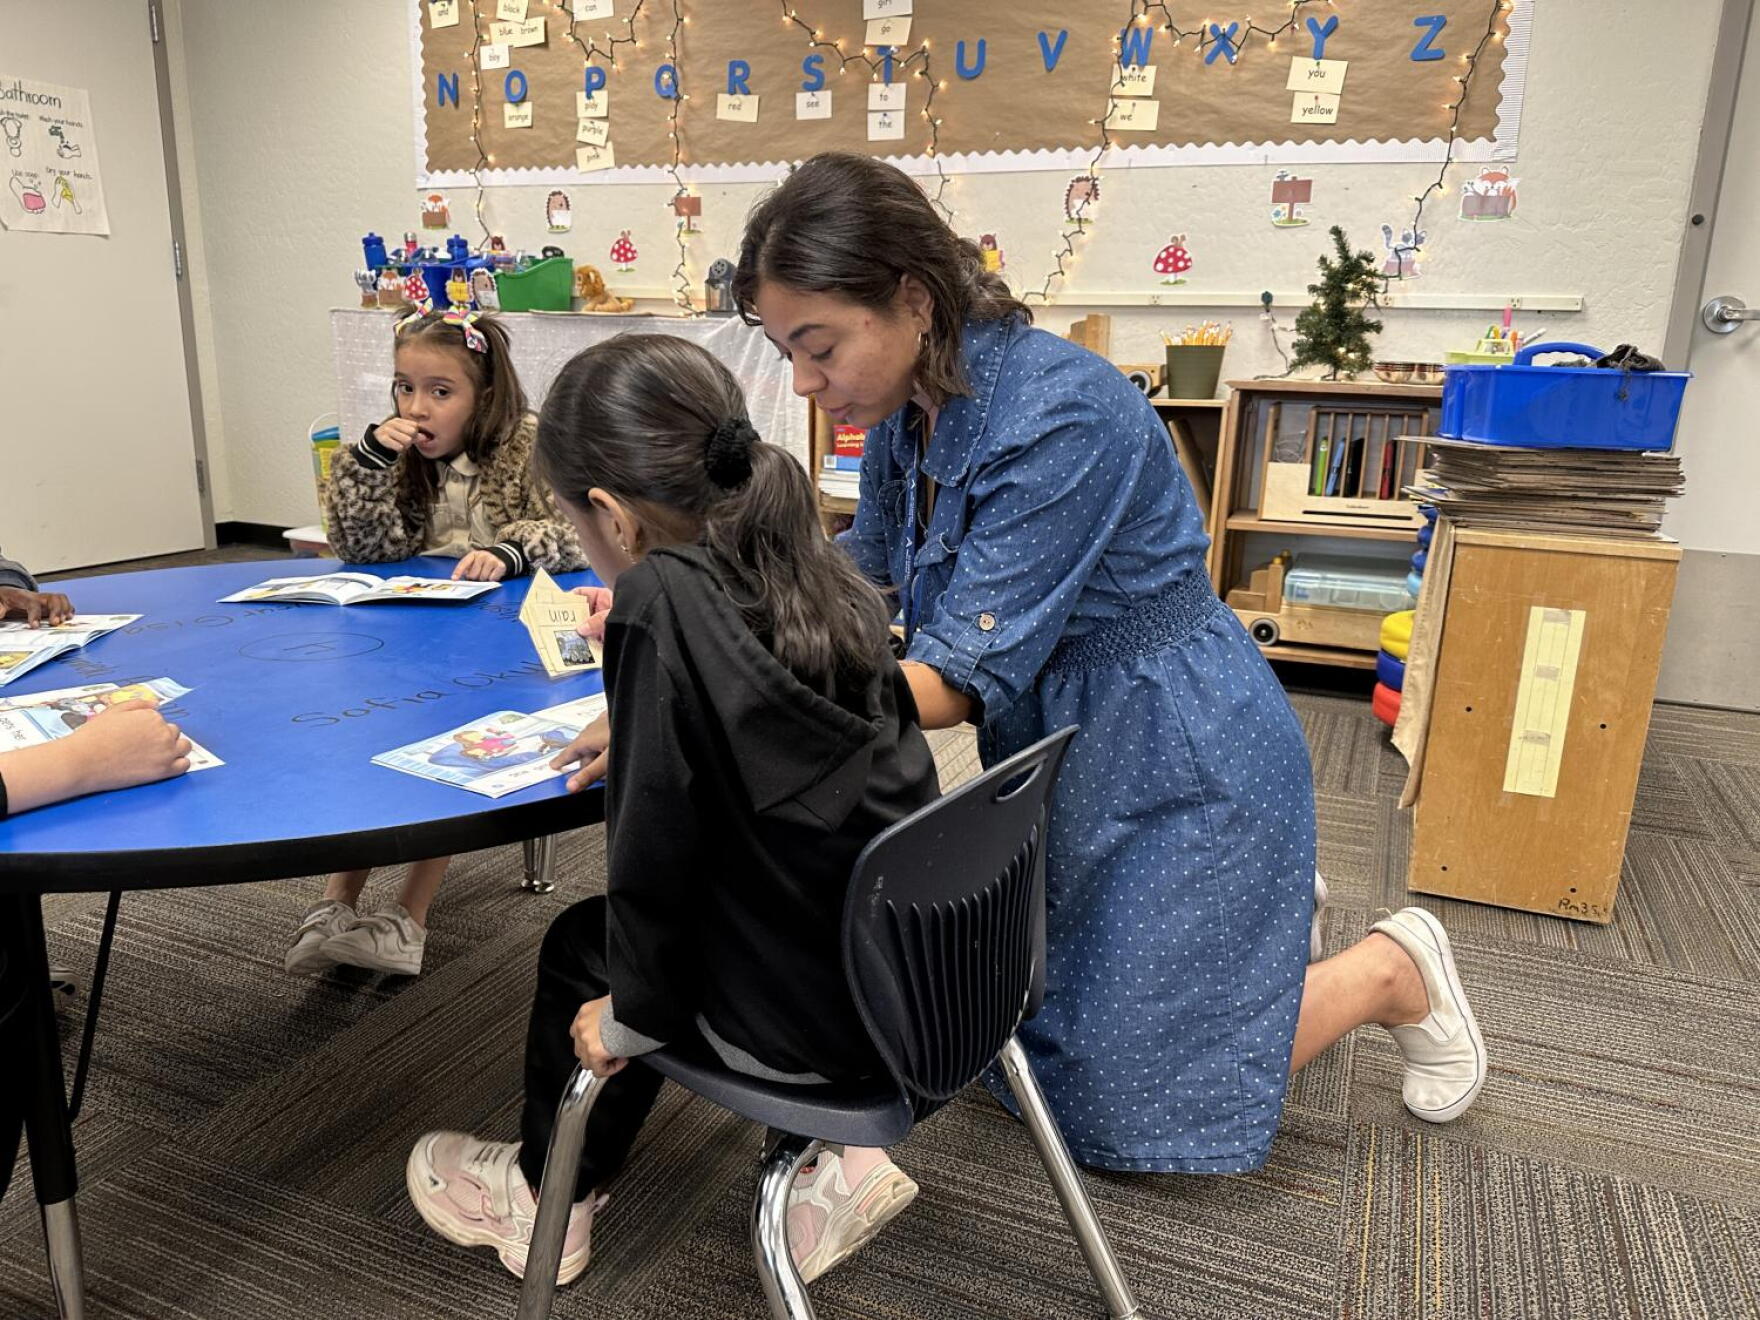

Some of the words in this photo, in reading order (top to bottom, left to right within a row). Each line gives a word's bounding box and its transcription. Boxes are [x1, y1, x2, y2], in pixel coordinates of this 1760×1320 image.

[881, 26, 891, 35] go
[437, 72, 459, 106] N
[504, 70, 527, 103] O
[585, 66, 606, 99] P
[655, 64, 679, 98] Q
[727, 60, 750, 95] R
[803, 55, 825, 92] S
[877, 46, 899, 87] T
[956, 39, 986, 80] U
[1038, 30, 1068, 72] V
[1120, 27, 1153, 69] W
[1205, 22, 1238, 65] X
[1306, 15, 1338, 60] Y
[1411, 15, 1447, 61] Z
[1308, 70, 1326, 80] you
[1302, 105, 1333, 116] yellow
[548, 608, 577, 623] rain
[291, 690, 449, 728] Sofia
